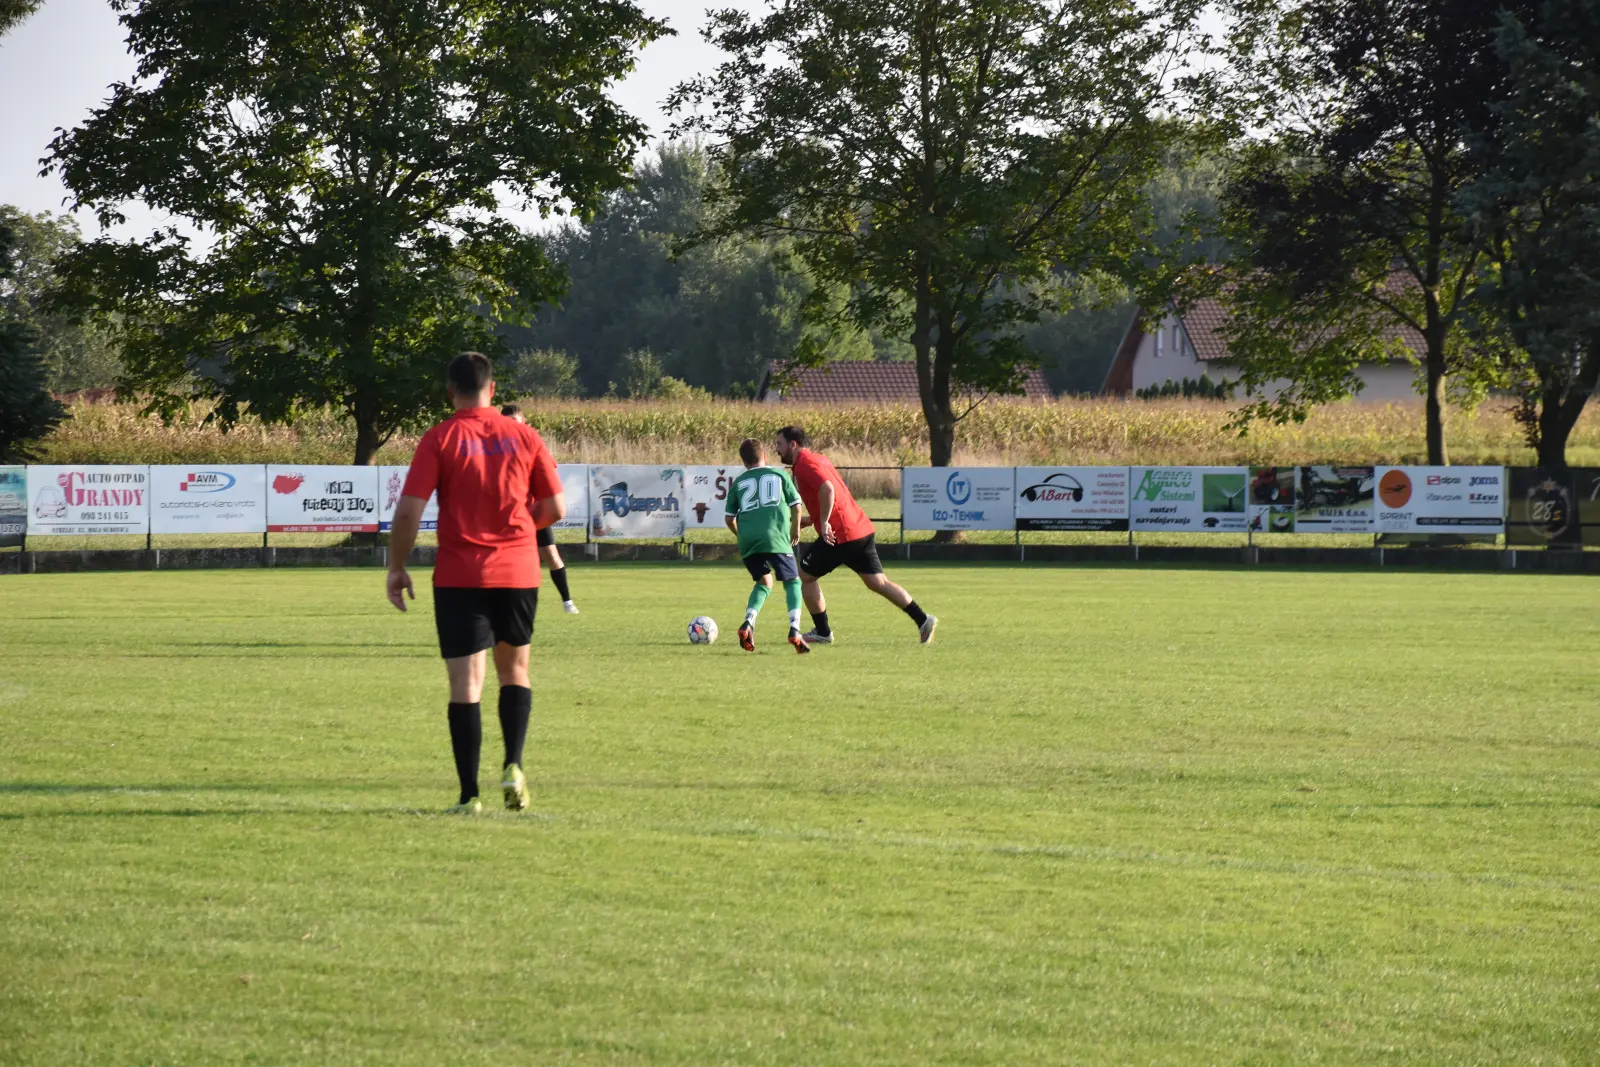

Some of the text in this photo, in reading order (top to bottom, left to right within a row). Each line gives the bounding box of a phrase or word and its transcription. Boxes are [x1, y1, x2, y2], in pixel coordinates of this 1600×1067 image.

[86, 473, 145, 483] AUTO OTPAD
[196, 474, 218, 483] AVM
[694, 476, 709, 485] OPG
[64, 471, 144, 506] GRANDY
[738, 474, 782, 511] 20
[952, 481, 965, 495] IT
[1036, 489, 1072, 501] ABart
